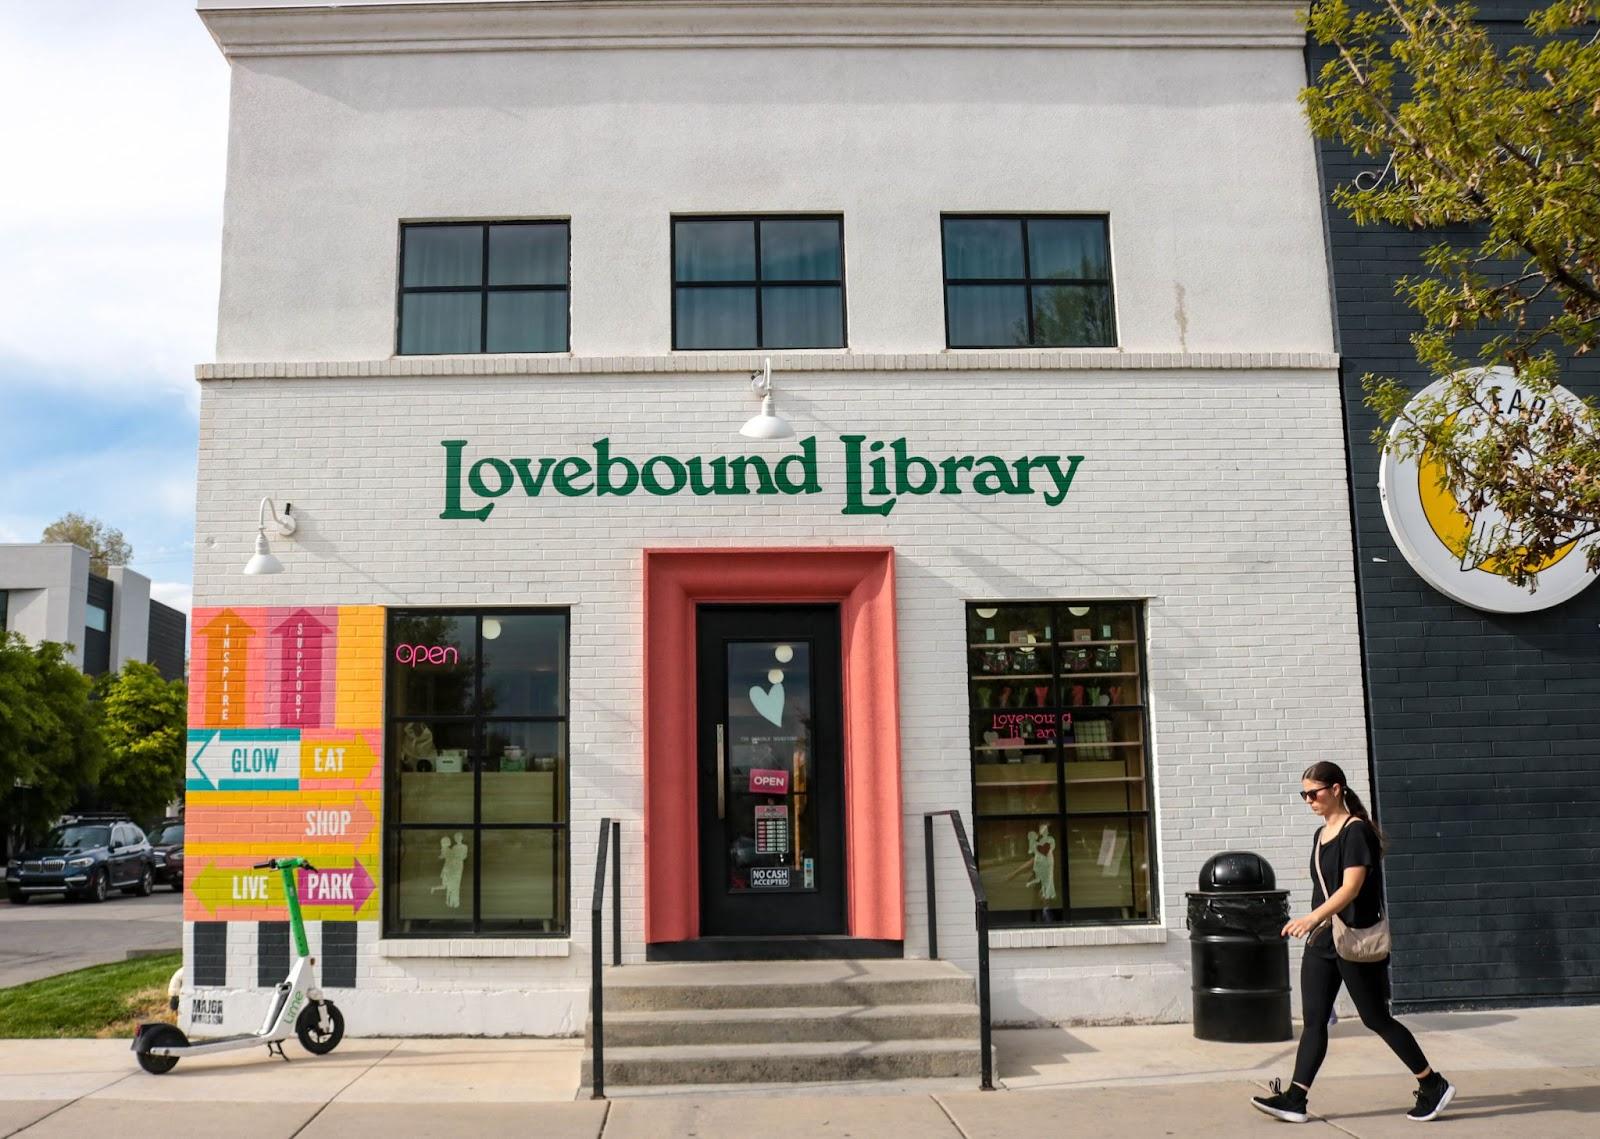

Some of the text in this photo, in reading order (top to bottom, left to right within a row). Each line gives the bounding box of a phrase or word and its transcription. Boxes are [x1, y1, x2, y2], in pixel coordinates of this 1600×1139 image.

[439, 435, 1085, 522] Lovebound Library
[222, 624, 230, 720] INSPIRE
[295, 623, 304, 720] SUPPORT
[231, 748, 279, 773] GLOW
[314, 747, 346, 772] EAT
[754, 776, 784, 787] OPEN
[305, 810, 351, 837] SHOP
[307, 873, 354, 900] PARK
[753, 870, 788, 879] NO CASH
[232, 876, 269, 900] LIVE
